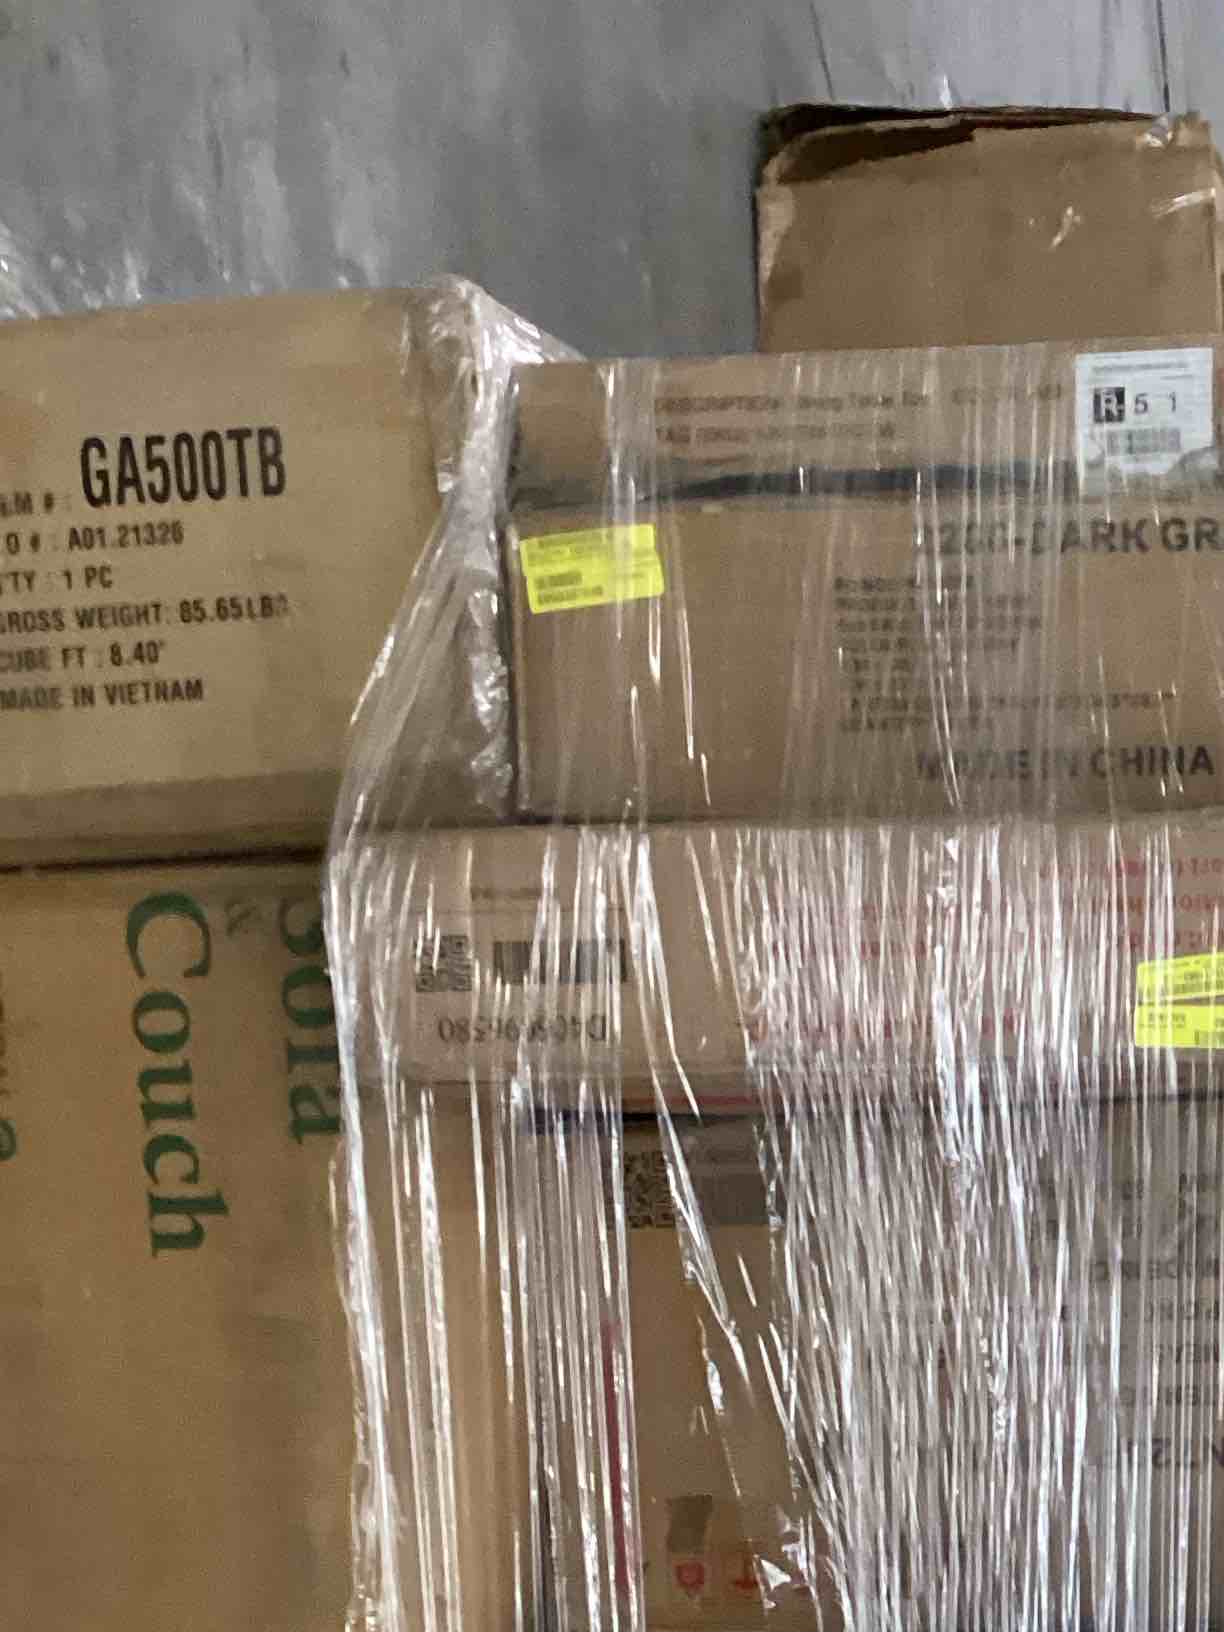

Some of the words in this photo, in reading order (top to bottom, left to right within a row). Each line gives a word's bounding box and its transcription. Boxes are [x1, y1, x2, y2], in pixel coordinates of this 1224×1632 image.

[80, 427, 287, 509] GA500TB
[85, 565, 113, 589] PC
[72, 684, 96, 708] IN
[104, 677, 204, 706] VIETNAM
[1089, 745, 1217, 778] CHINA
[125, 890, 231, 1258] Couch
